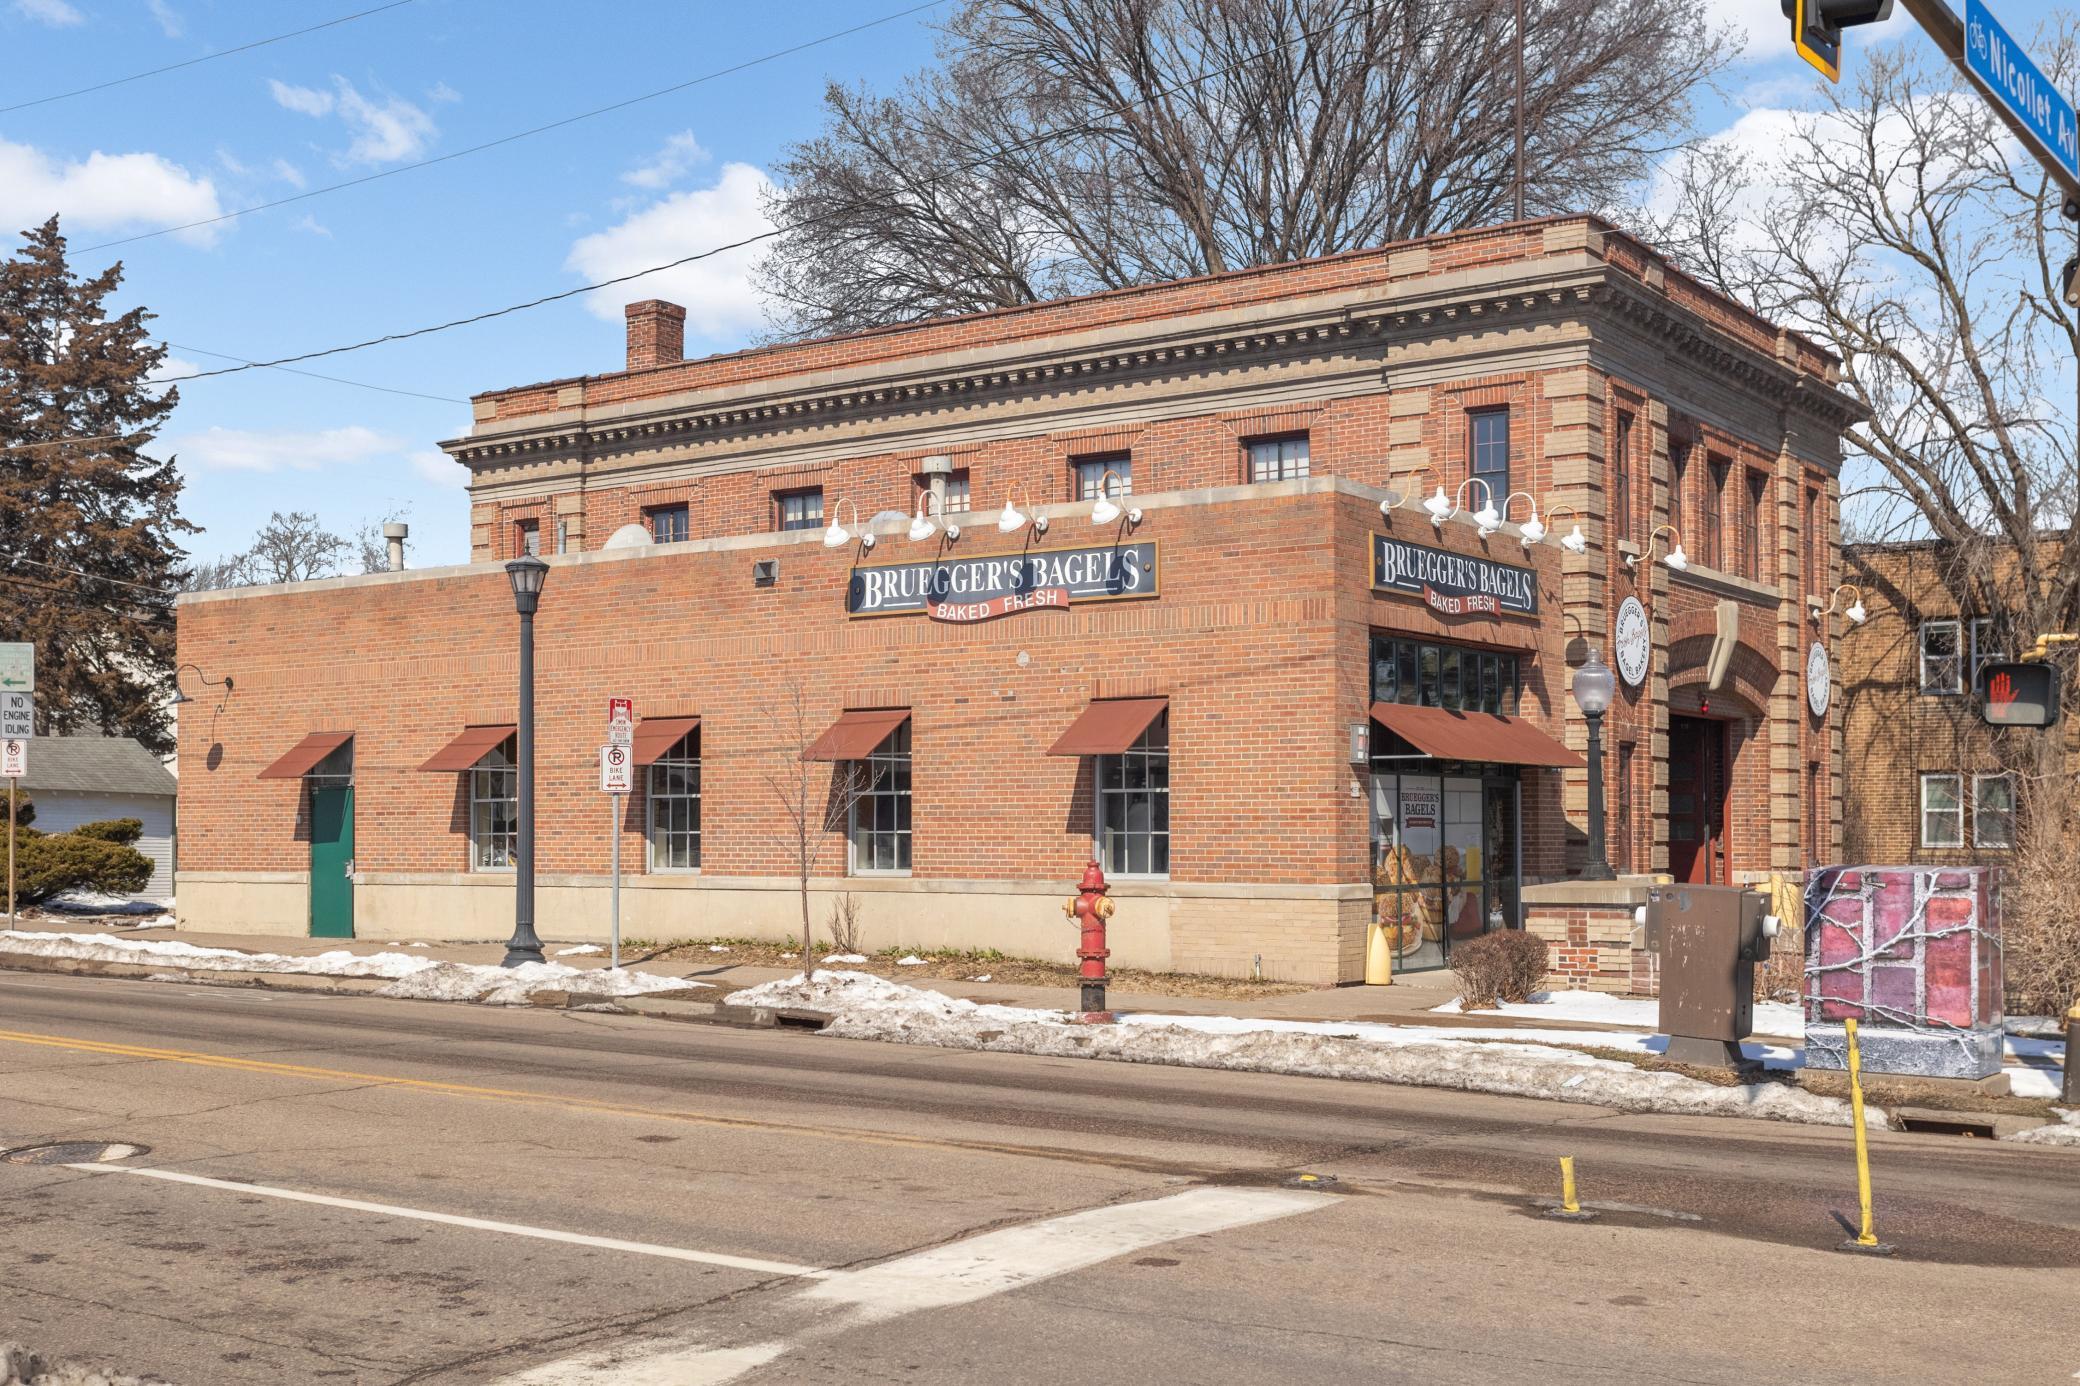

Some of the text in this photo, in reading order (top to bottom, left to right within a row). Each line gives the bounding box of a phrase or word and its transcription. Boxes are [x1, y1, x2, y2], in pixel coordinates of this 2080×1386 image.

[1990, 29, 2075, 160] Nicollet Av
[863, 549, 1140, 609] BRUEGGER'S BAGELS
[1382, 541, 1532, 610] BRUEGGER'S BAGELS
[936, 590, 1058, 620] BAKED FRESH
[1430, 591, 1495, 613] BAKED FRESH
[11, 696, 23, 708] NO
[3, 711, 31, 720] ENGINE
[5, 724, 29, 734] IDLING
[1401, 792, 1440, 802] BRUEGGER'S
[1405, 803, 1436, 815] BAGELS
